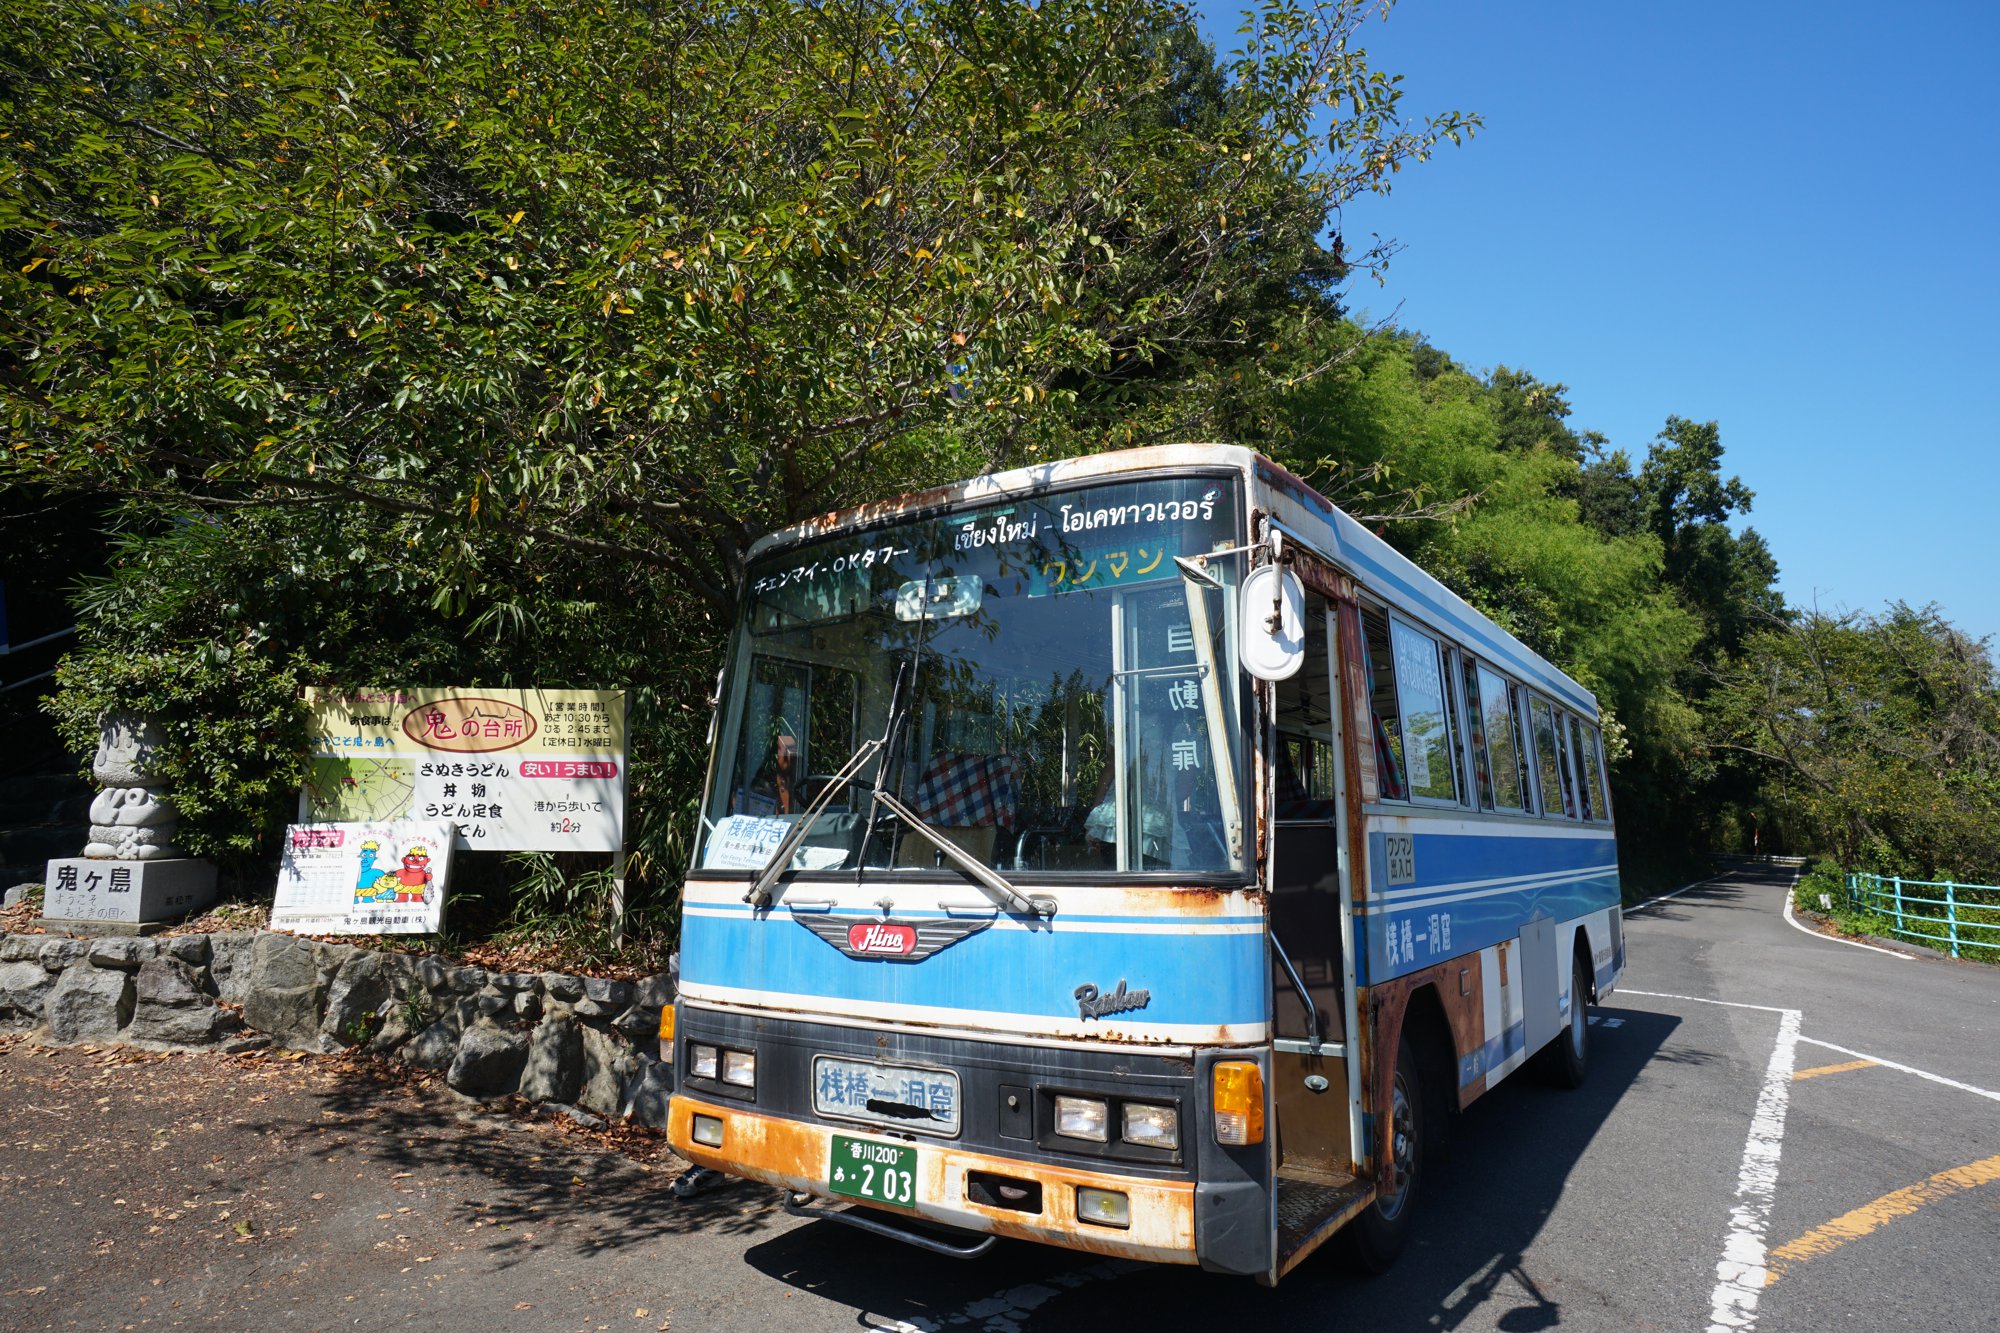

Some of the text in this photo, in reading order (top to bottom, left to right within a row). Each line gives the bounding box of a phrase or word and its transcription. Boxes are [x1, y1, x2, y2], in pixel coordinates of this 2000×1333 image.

[954, 512, 1037, 550] เชียงใหม่
[1060, 491, 1216, 533] โอเคทาวเวอร์
[1043, 547, 1164, 587] ワンマン
[350, 716, 392, 726] お食事は
[421, 707, 523, 740] 鬼の台所
[544, 713, 610, 723] あさ 10:30 から
[544, 725, 610, 734] ひる 2:45 まで
[420, 763, 510, 778] さぬきうどん
[425, 803, 503, 818] うどん定食
[534, 802, 603, 813] 港から歩いて
[457, 824, 487, 838] でん
[550, 817, 582, 833] 約2分
[727, 818, 784, 844] 桟橋行き
[1387, 837, 1412, 857] ワンマン
[1390, 858, 1412, 879] 出入口
[55, 865, 132, 893] 鬼ヶ島
[55, 893, 98, 906] ようこそ
[64, 906, 130, 920] おとぎの国へ
[859, 924, 904, 952] Hino
[1074, 978, 1150, 1022] Rainbow
[834, 1166, 845, 1182] あ
